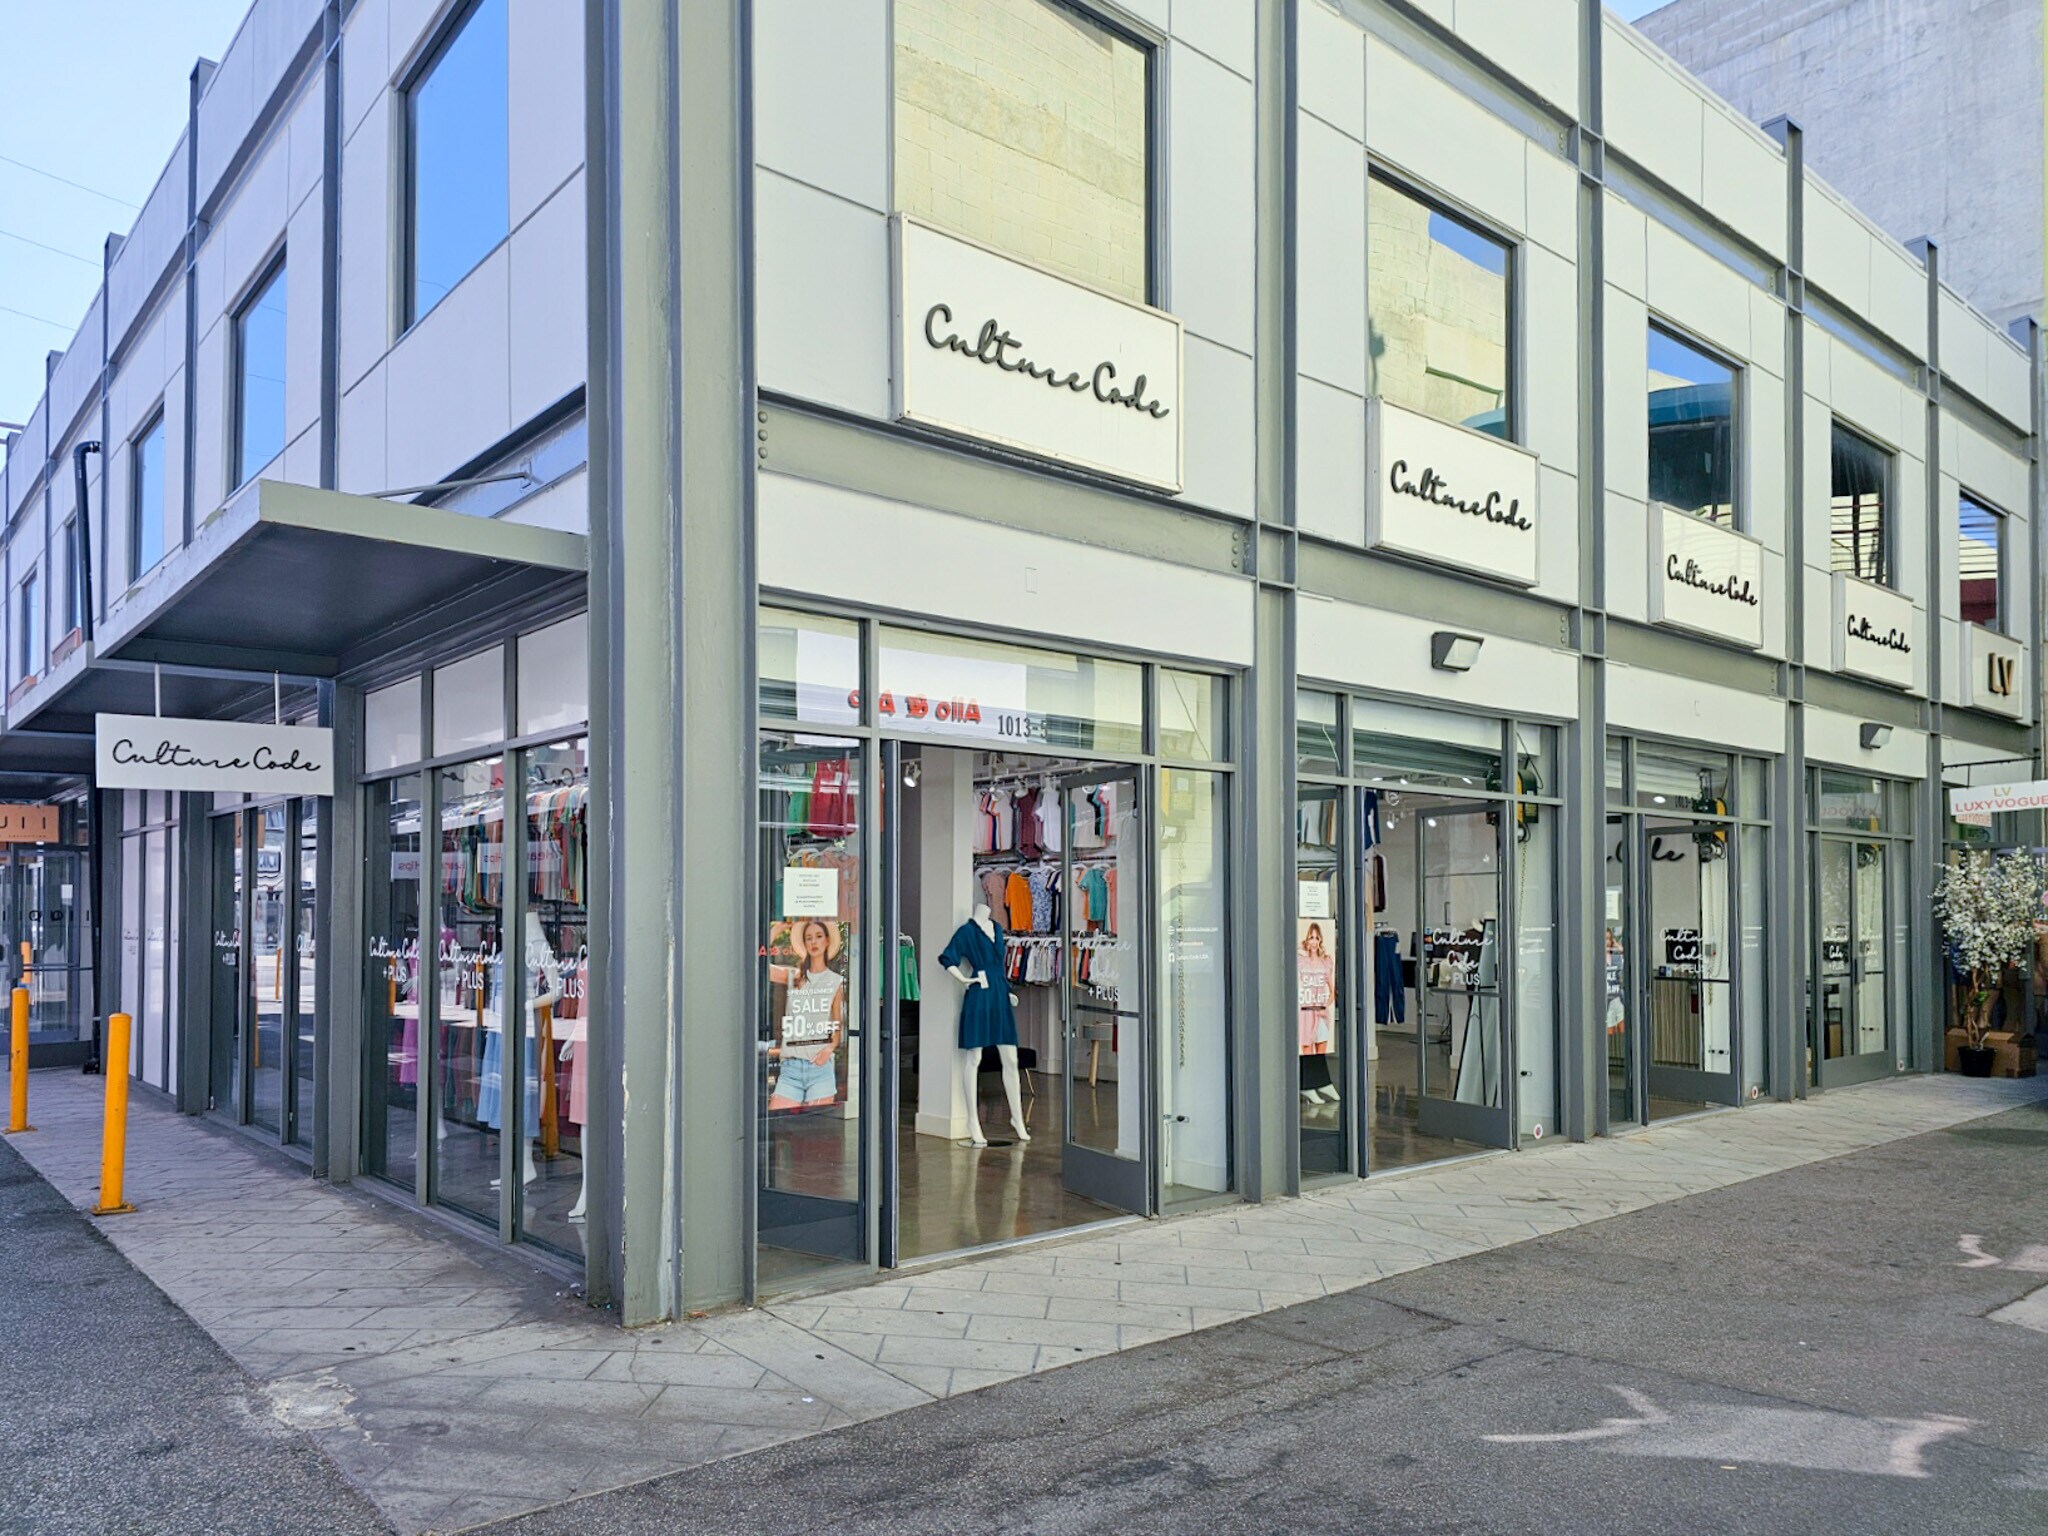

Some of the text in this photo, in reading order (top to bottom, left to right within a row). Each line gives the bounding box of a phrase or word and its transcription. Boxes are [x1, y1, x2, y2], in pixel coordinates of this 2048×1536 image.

[925, 303, 1170, 419] Culture Code
[1390, 460, 1532, 531] Culture Code
[1667, 554, 1757, 606] Culture Code
[1988, 652, 2014, 696] LV
[112, 738, 321, 772] Culture Code
[1955, 795, 2048, 812] LUXYVOGUE
[1993, 786, 2011, 797] LV
[1433, 928, 1493, 946] Culture
[1303, 975, 1325, 987] SALE
[792, 998, 830, 1014] SALE
